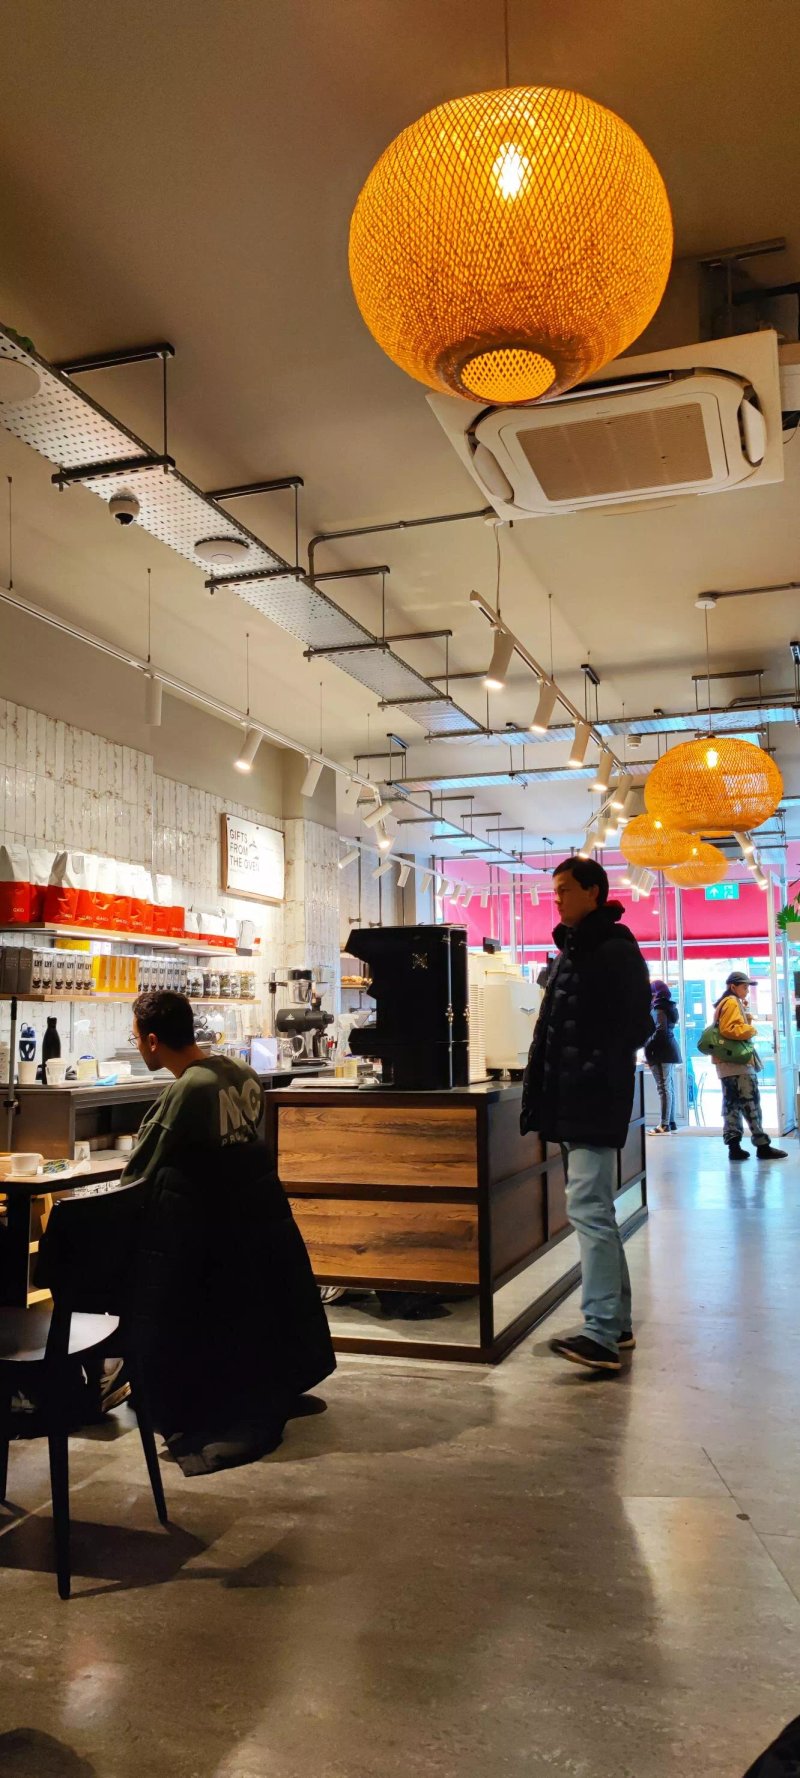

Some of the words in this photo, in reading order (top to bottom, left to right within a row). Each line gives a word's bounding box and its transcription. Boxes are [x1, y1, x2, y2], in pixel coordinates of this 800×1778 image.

[230, 829, 248, 844] GIFTS
[230, 842, 248, 856] FROM
[230, 855, 243, 868] THE
[244, 859, 259, 873] OVEN
